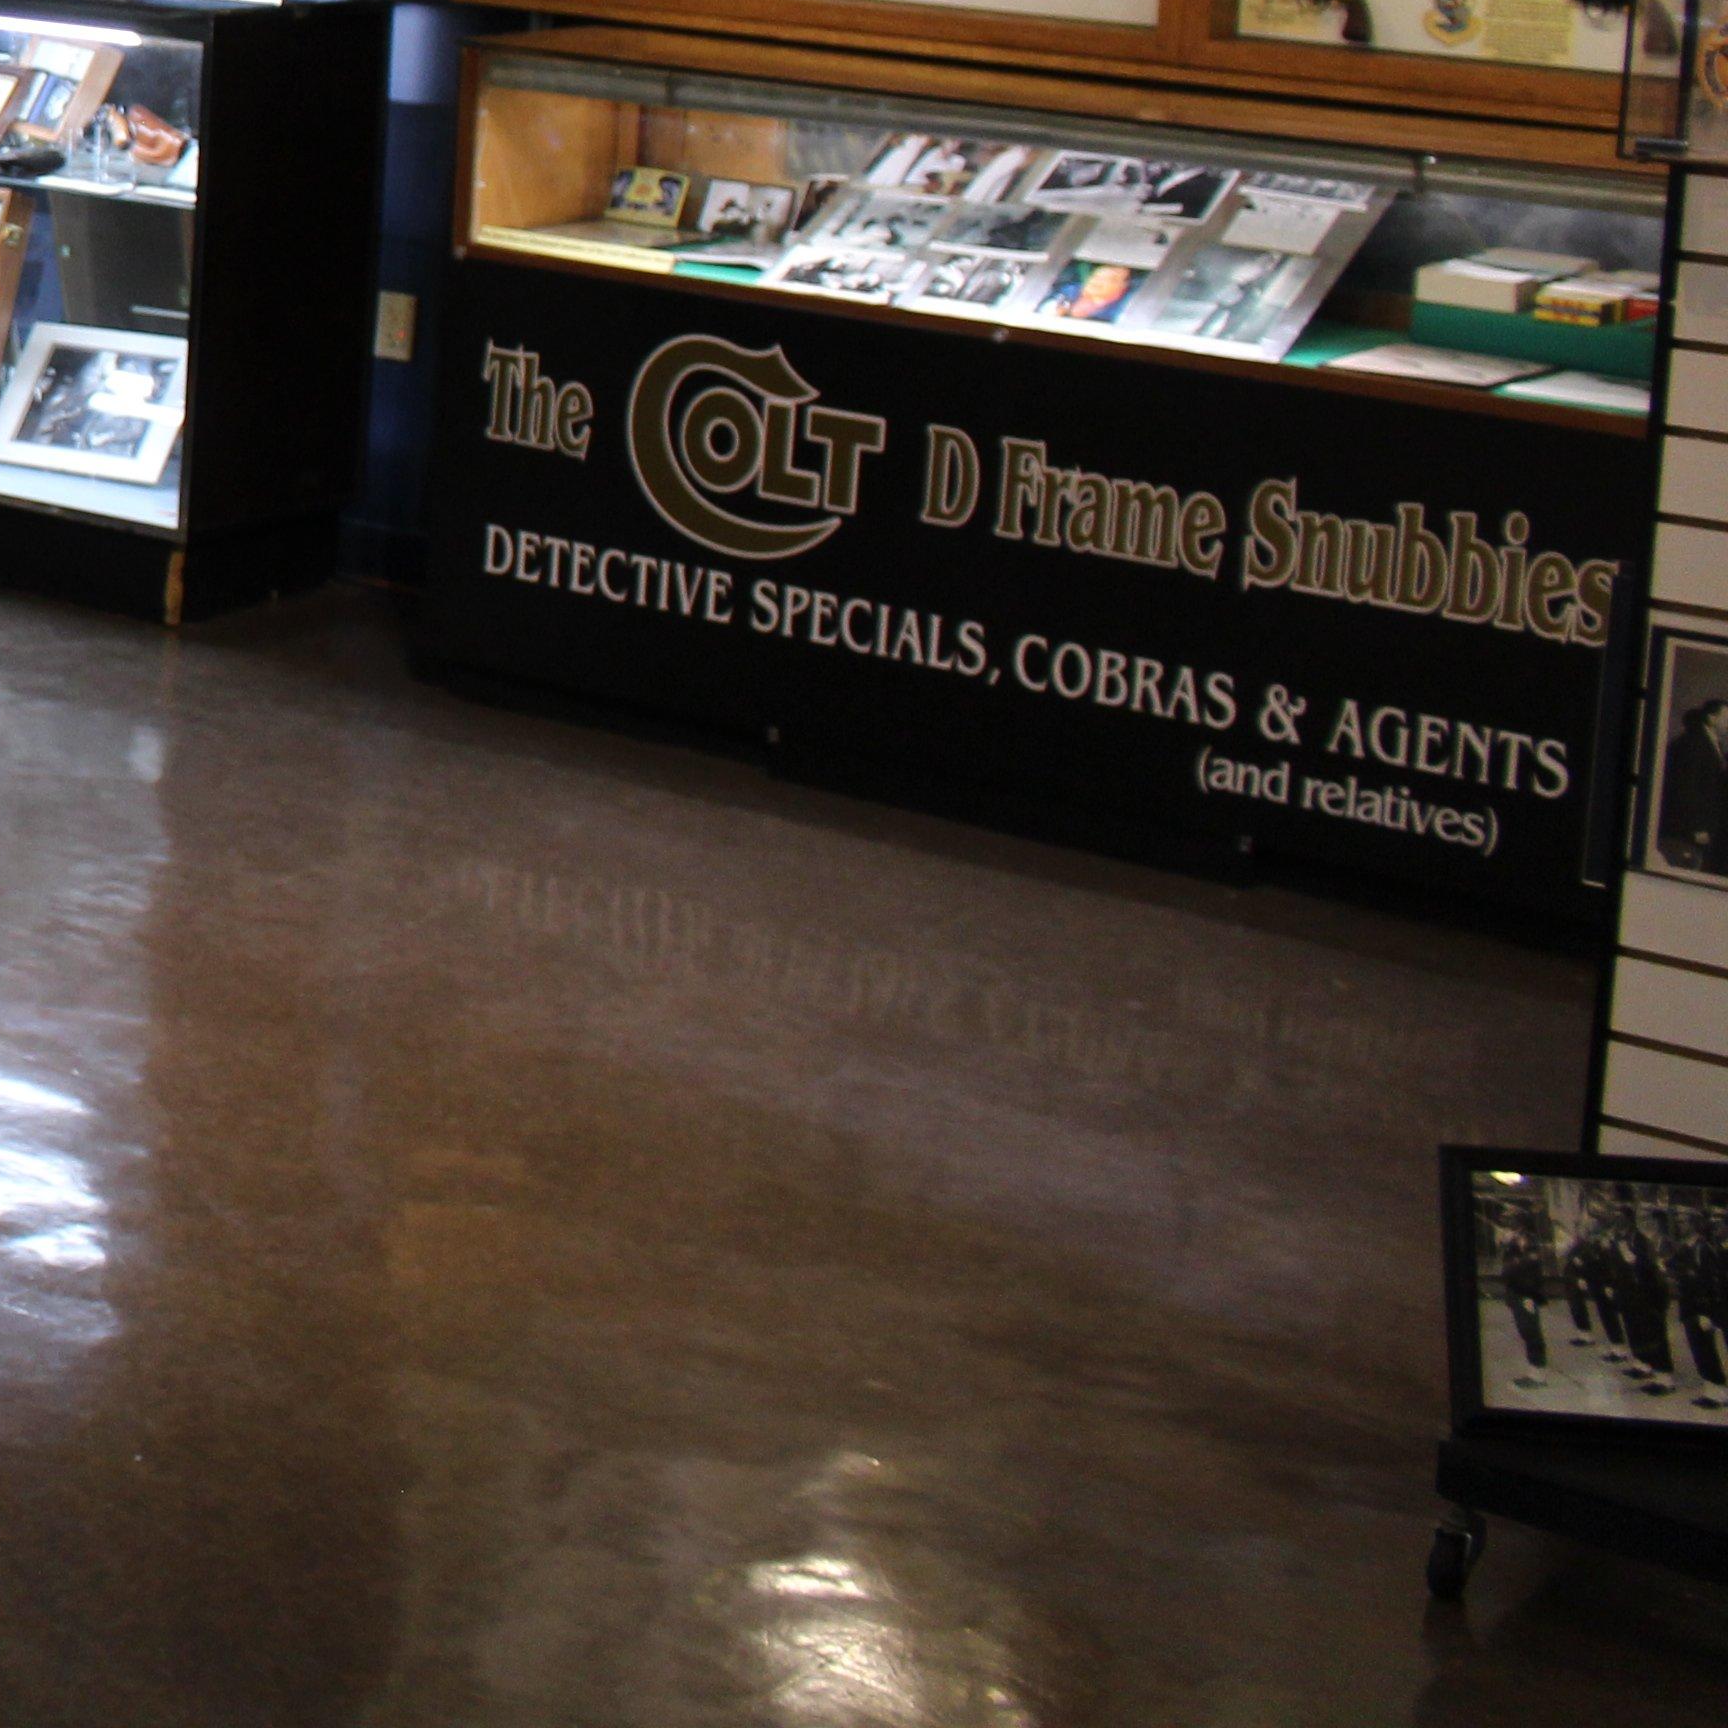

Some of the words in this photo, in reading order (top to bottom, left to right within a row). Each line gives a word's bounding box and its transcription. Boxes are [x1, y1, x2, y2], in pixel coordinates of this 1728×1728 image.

[483, 337, 593, 461] The
[627, 333, 887, 559] COLT
[920, 424, 980, 527] D
[995, 435, 1227, 579] Frame
[1243, 477, 1620, 647] Snubbies
[485, 523, 734, 624] DETECTIVE
[750, 579, 1001, 685] SPECIALS,
[1014, 635, 1237, 729] COBRAS
[1257, 683, 1307, 745] &
[1326, 698, 1570, 799] AGENTS
[1196, 745, 1288, 805] (and
[1300, 776, 1498, 857] relatives)
